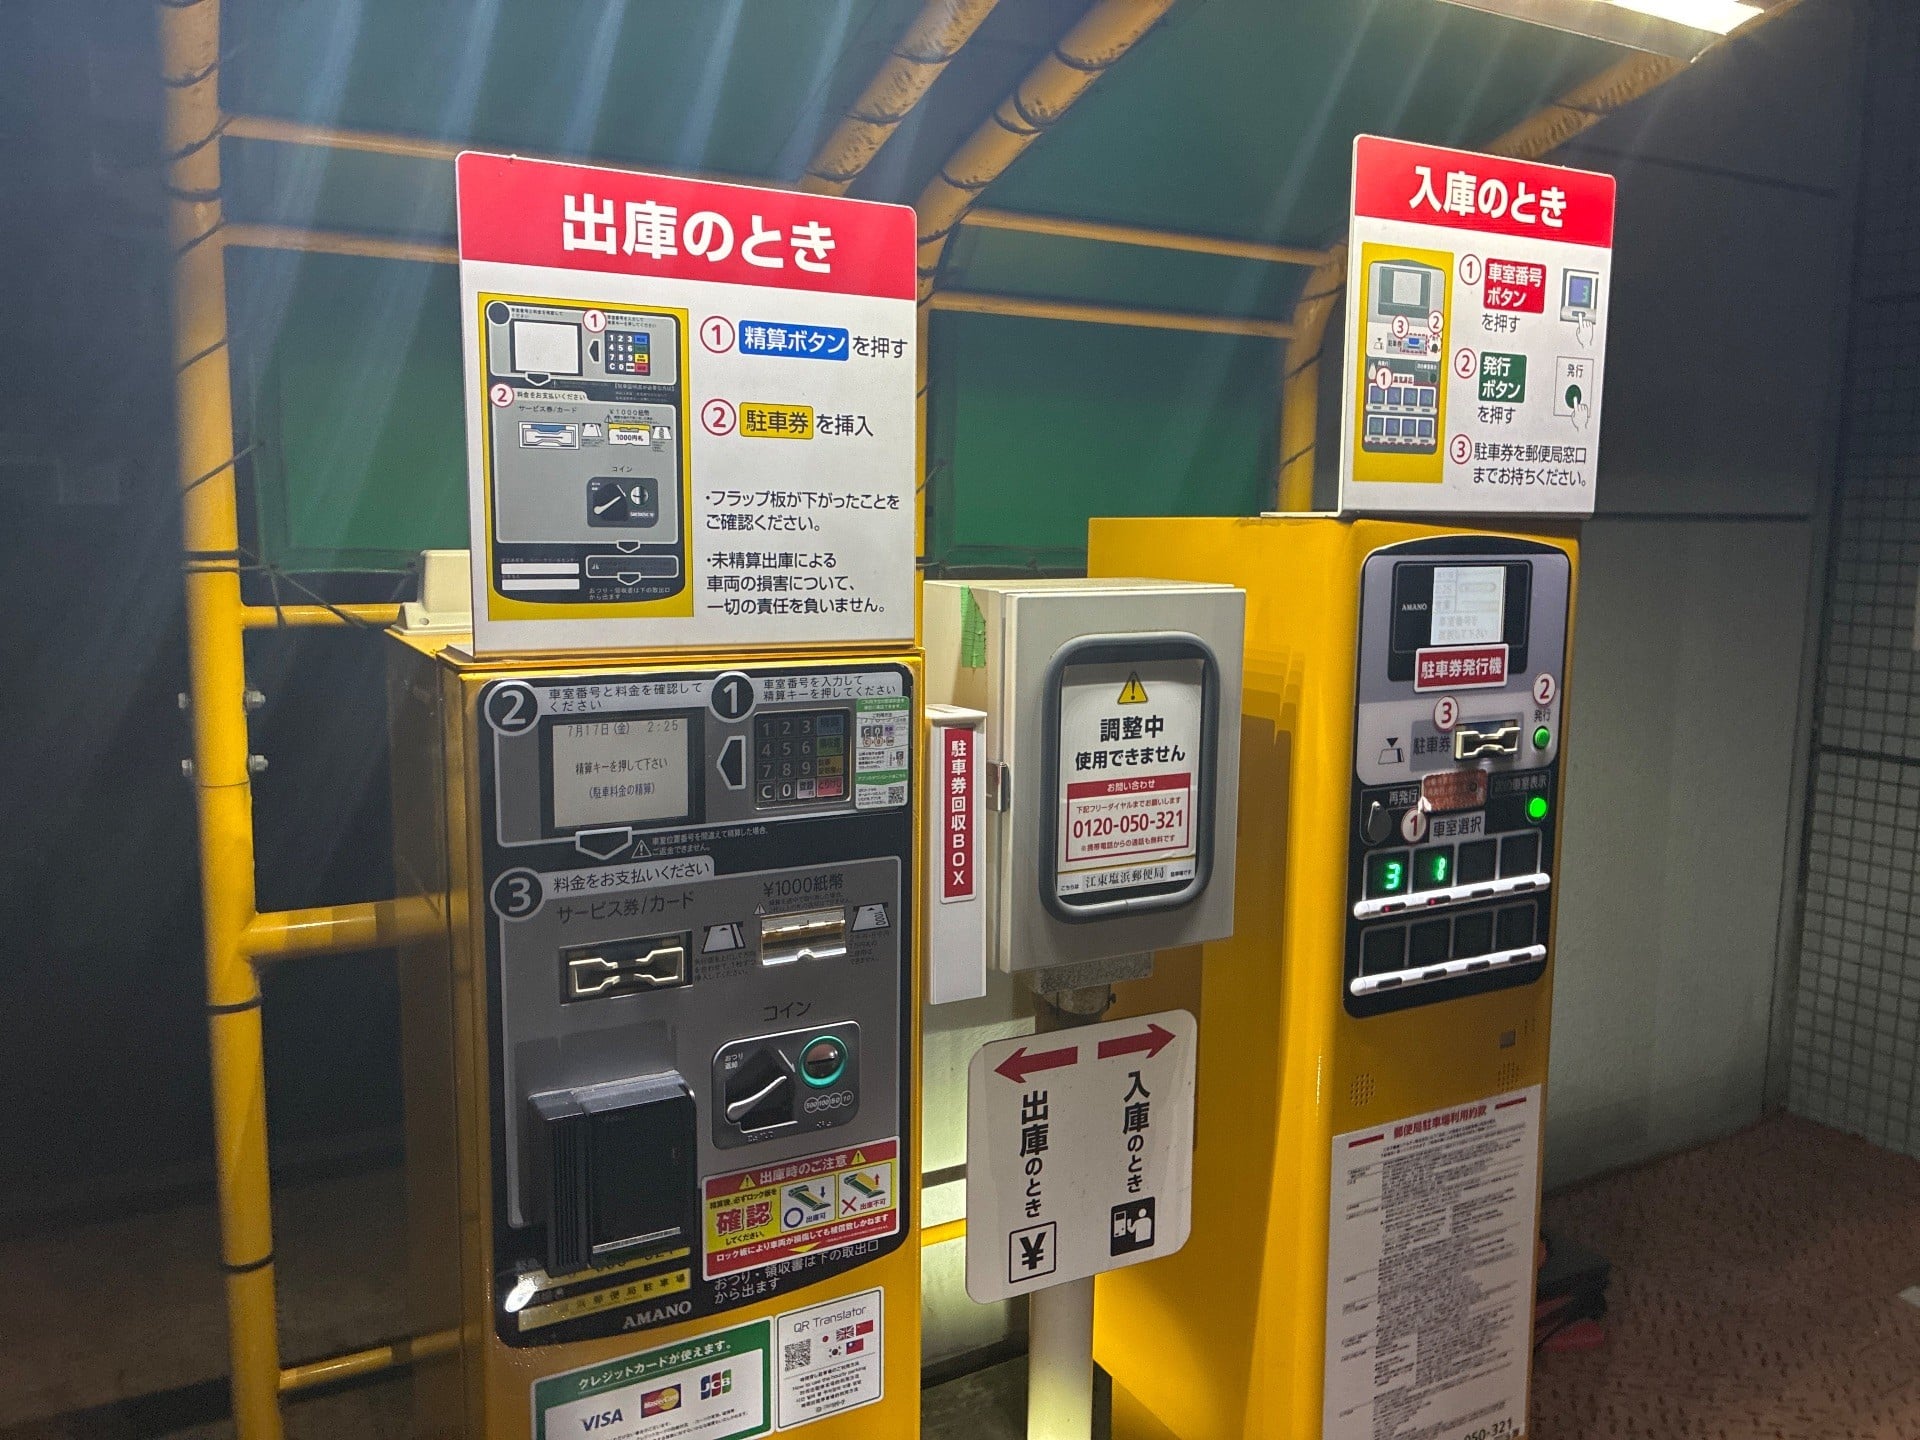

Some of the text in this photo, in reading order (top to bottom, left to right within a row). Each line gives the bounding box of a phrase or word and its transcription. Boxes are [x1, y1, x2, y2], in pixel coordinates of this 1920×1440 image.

[1409, 166, 1567, 228] 入庫のとき
[562, 193, 836, 274] 出庫のとき
[1487, 263, 1543, 285] 車室番号
[1487, 287, 1527, 307] ボタン
[590, 314, 597, 327] 1
[1397, 320, 1404, 333] 3
[1433, 316, 1439, 329] 2
[1481, 315, 1521, 332] を押す
[745, 326, 846, 355] 精算ボタン
[852, 336, 908, 358] を押す
[1482, 357, 1511, 377] 発行
[1566, 364, 1584, 378] 発行
[497, 389, 507, 402] 2
[1482, 379, 1521, 399] ボタン
[746, 410, 809, 433] 駐車券
[816, 415, 873, 437] を挿入
[1477, 407, 1516, 424] を押す
[1474, 444, 1587, 465] 駐車券を郵便局窓口
[1473, 466, 1588, 486] までお持ちください。
[706, 490, 899, 511] ・フラップ板が下がったことを
[707, 513, 821, 532] ご確認ください。
[707, 551, 836, 570] ・未精算出庫による
[707, 573, 856, 593] 車両の損害について、
[707, 597, 886, 615] 一切の責任を負いません。
[1401, 603, 1428, 611] AMANO
[1421, 657, 1502, 679] 駐車券発行機
[722, 676, 862, 714] 1 車室番号を入力して
[763, 685, 897, 701] 精算キーを押してください
[1540, 680, 1549, 699] 2
[501, 682, 703, 725] 2 車室番号と料金を確認して
[549, 699, 602, 712] ください
[1442, 703, 1451, 723] 3
[1534, 710, 1551, 722] 発行
[567, 720, 679, 736] 7月17日(金) 2:25
[763, 723, 768, 736] 1
[782, 722, 791, 735] 2
[802, 720, 810, 733] 3
[1100, 715, 1164, 742] 調整中
[762, 744, 770, 755] 4
[783, 742, 791, 755] 5
[802, 741, 810, 754] 6
[1413, 736, 1452, 756] 駐車券
[575, 758, 668, 775] 精算キーを押して下さい
[1075, 745, 1185, 770] 使用できません
[763, 765, 771, 777] 7
[783, 763, 791, 776] 8
[802, 762, 810, 774] 9
[588, 784, 656, 799] (駐車料金の精算)
[762, 783, 791, 798] C 0
[1107, 780, 1155, 793] お問い合わせ
[1076, 796, 1181, 814] 下記フリーダイヤルまでお願いします
[1389, 791, 1418, 805] 再発行
[951, 740, 967, 885] 駐車券回収BOX
[1074, 810, 1183, 839] 0120-050-321
[1433, 816, 1482, 838] 車室選択
[1081, 834, 1176, 851] ※携帯電話からの通話も無料です
[763, 874, 844, 897] ¥1000紙幣
[1086, 868, 1164, 888] 江東塩浜郵便局
[1385, 864, 1400, 890] 3
[508, 863, 710, 912] 3 料金をお支払いください
[558, 892, 695, 924] サービス券/カード
[763, 1001, 811, 1021] コイン
[1123, 1071, 1151, 1193] 入庫のとき
[1020, 1090, 1049, 1218] 出庫のとき
[760, 1155, 847, 1185] 出庫時のご注意
[860, 1199, 886, 1210] 出庫不可
[716, 1201, 773, 1235] 確認
[725, 1231, 765, 1246] してください。
[714, 1240, 879, 1292] おつり・領収書は下の取出口
[714, 1276, 781, 1304] から出ます
[623, 1301, 692, 1329] AMANO
[793, 1305, 867, 1333] QR Translator
[579, 1340, 732, 1389] クレジットカードが使えます。
[581, 1407, 623, 1431] VISA
[701, 1377, 731, 1392] JCB
